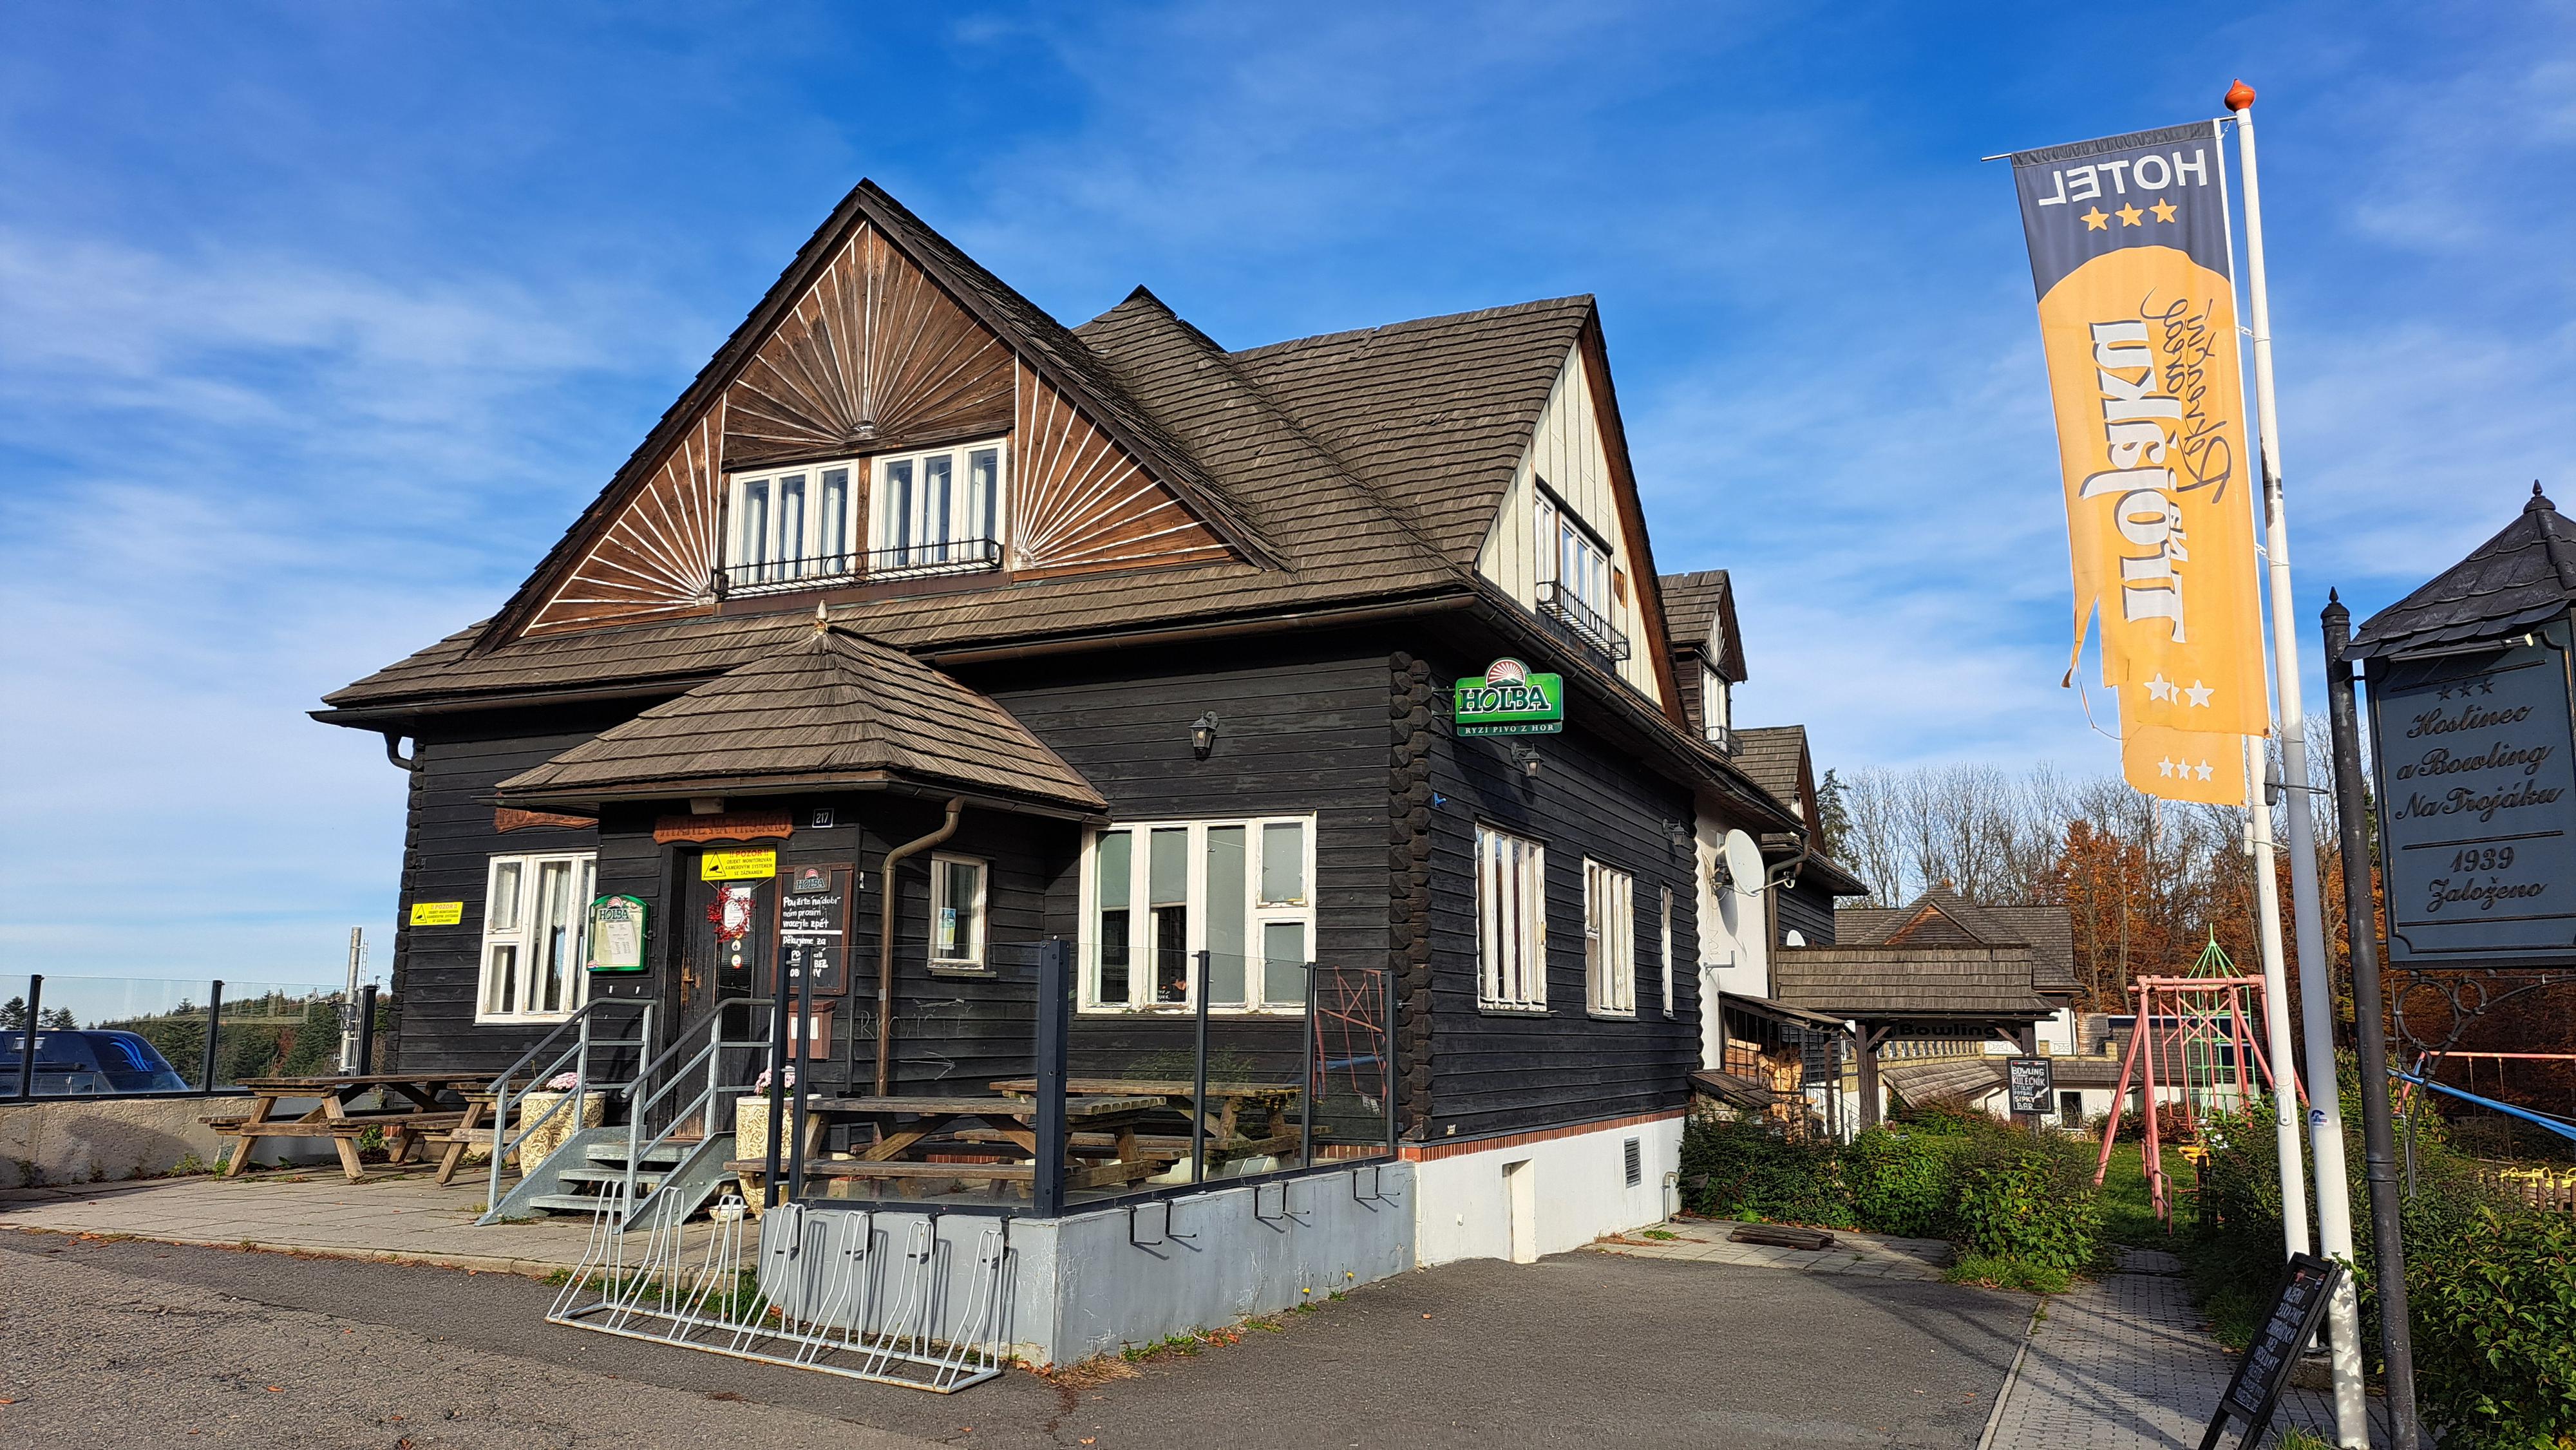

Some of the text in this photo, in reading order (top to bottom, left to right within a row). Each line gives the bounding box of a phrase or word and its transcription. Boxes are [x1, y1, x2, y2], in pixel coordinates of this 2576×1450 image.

[1459, 684, 1551, 714] HOLBA
[1465, 724, 1488, 734] RYZÍ
[2407, 704, 2535, 739] Hostinec
[2397, 742, 2555, 780] a Bowling
[2395, 779, 2565, 822] Na Trojáku
[816, 812, 829, 823] 217
[2450, 846, 2515, 872] 1939
[796, 879, 825, 889] HOLBA
[2426, 876, 2548, 913] Založeno
[599, 909, 629, 920] HOLBA
[814, 959, 828, 968] BEZ
[1899, 1023, 1999, 1039] Bowling
